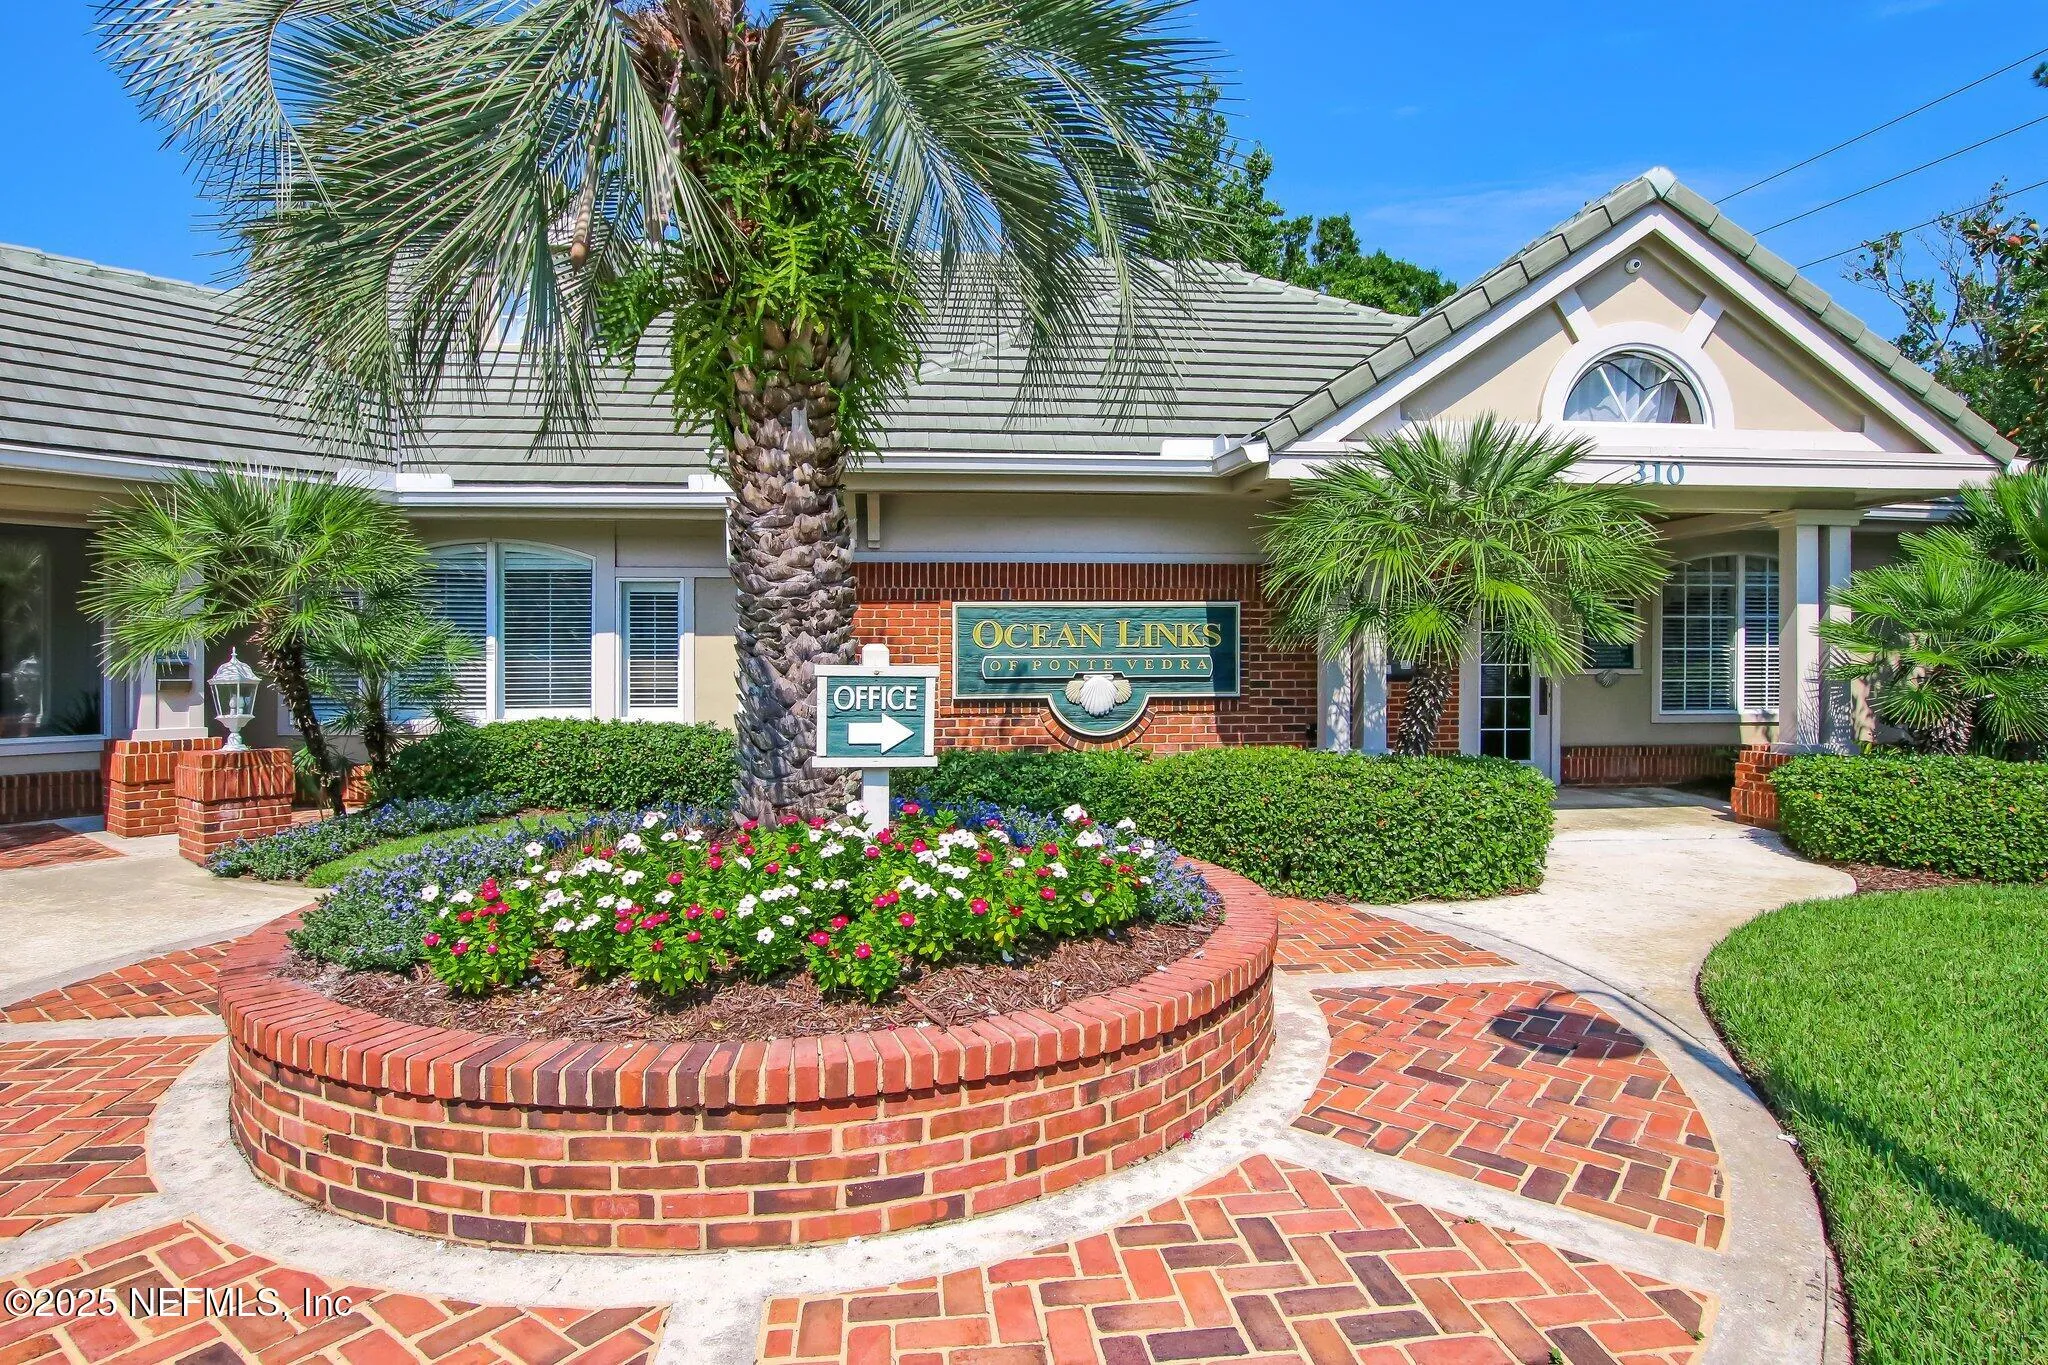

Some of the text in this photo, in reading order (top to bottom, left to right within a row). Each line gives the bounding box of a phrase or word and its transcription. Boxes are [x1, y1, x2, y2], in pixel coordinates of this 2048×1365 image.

[1631, 461, 1685, 485] 310
[972, 620, 1222, 649] OCEAN LINKS
[990, 659, 1210, 671] OF PONTE VEDRA
[833, 685, 918, 711] OFFICE
